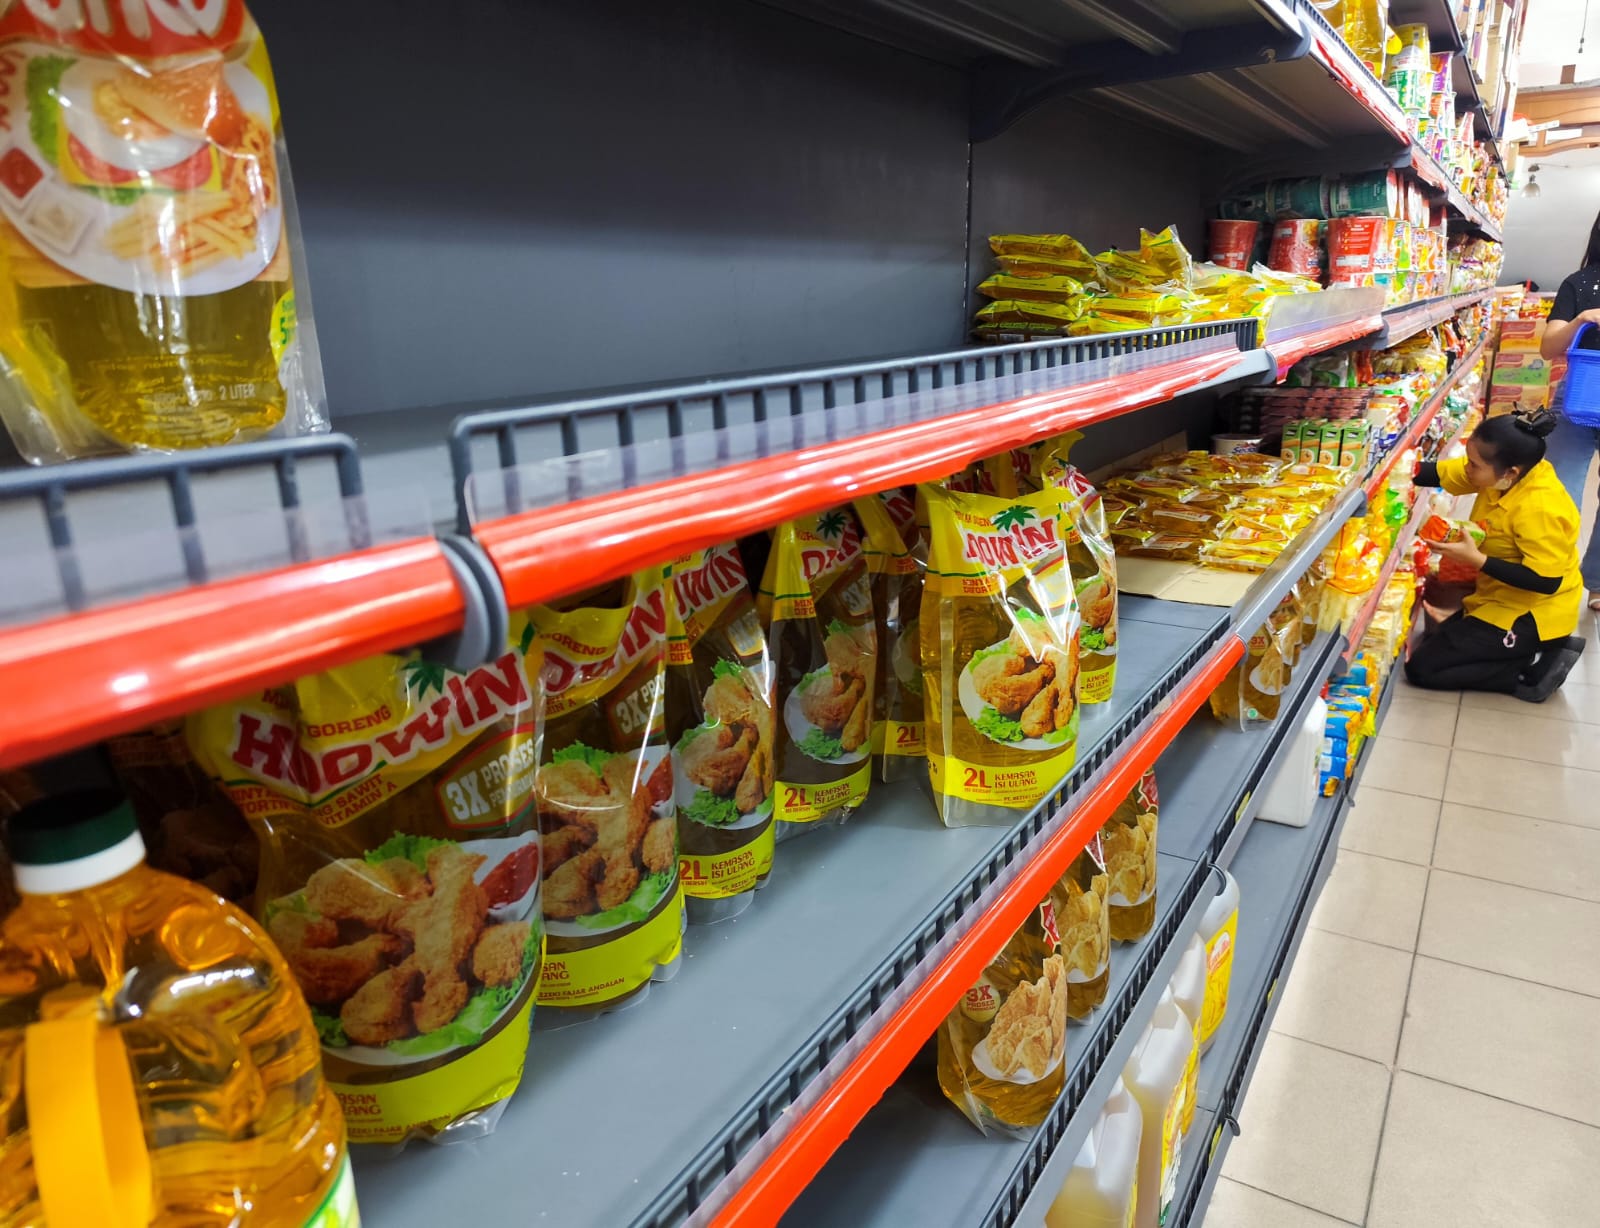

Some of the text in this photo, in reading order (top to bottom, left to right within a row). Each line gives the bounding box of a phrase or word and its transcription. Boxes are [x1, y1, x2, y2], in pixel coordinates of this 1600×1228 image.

[229, 383, 256, 399] LITER
[306, 704, 392, 739] GORENG
[615, 691, 648, 735] 3X
[896, 725, 920, 744] 2L
[480, 737, 535, 789] PROSES
[964, 767, 992, 789] 2L
[994, 770, 1035, 781] KEMASAN
[994, 778, 1037, 789] ISI ULANG
[335, 774, 384, 808] SAWIT
[386, 781, 397, 794] A
[446, 770, 491, 821] 3X
[784, 787, 811, 807] 2L
[814, 782, 849, 797] KEMASAN
[827, 790, 850, 802] ULANG
[680, 860, 708, 880] 2L
[711, 851, 753, 870] KEMASAN
[711, 858, 755, 879] ISI ULANG
[588, 977, 625, 992] ANDALAN
[966, 984, 993, 1002] 3X
